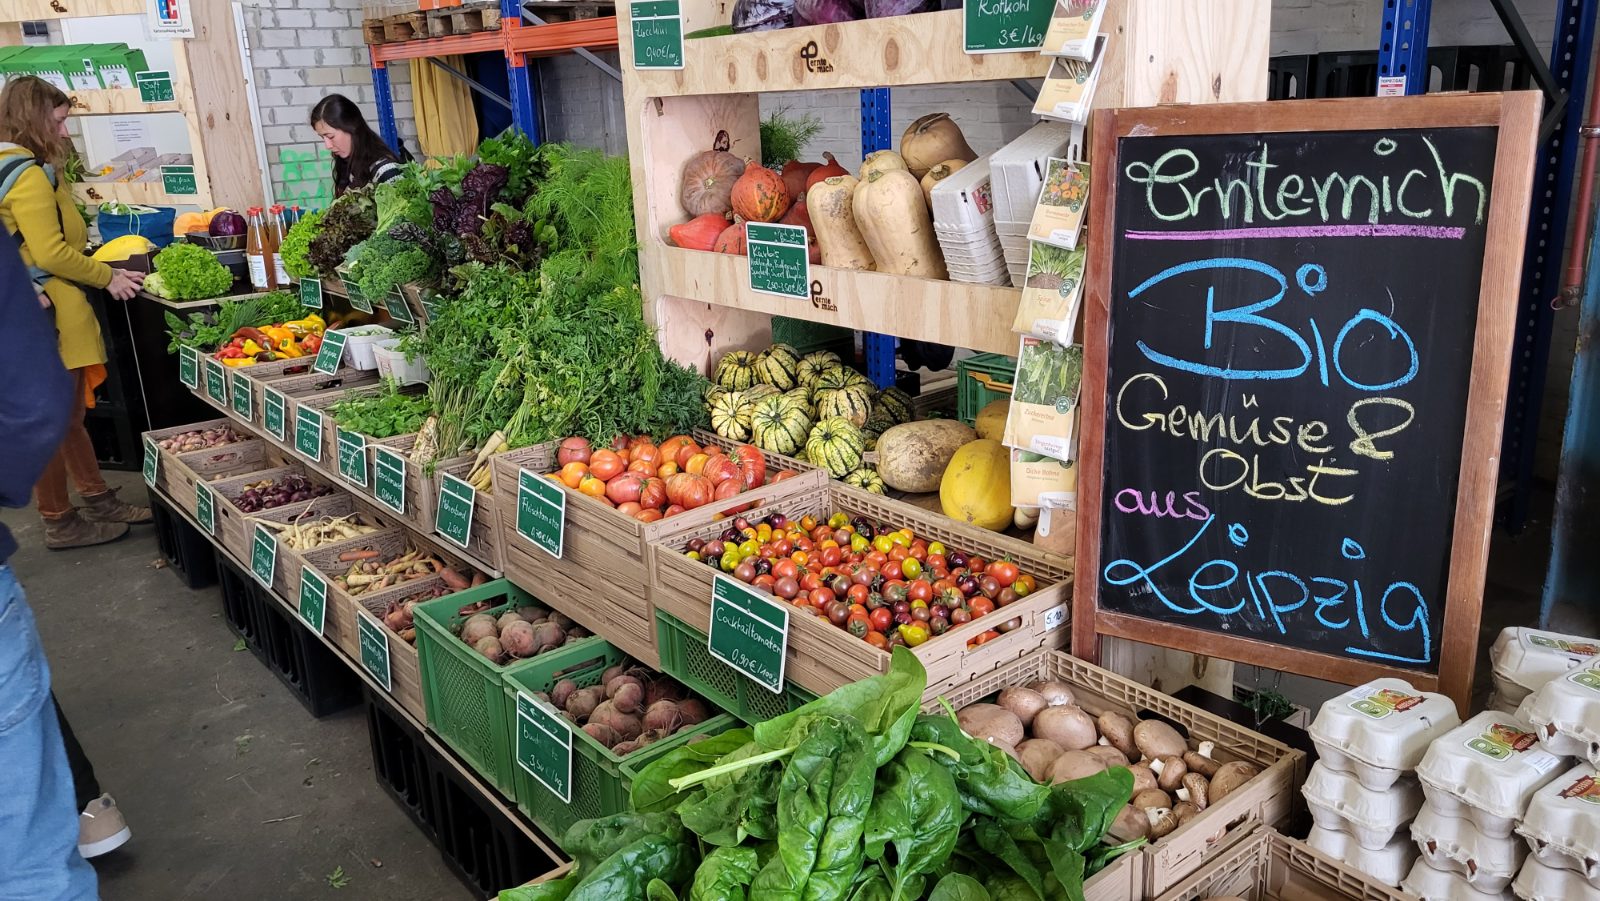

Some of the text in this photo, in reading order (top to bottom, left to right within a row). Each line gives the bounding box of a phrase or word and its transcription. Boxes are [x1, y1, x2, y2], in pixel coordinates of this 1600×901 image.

[978, 0, 1030, 17] Rotkohl
[1116, 373, 1333, 453] Gemüse
[1114, 487, 1211, 521] aus
[1200, 448, 1359, 507] Obst
[1104, 513, 1431, 663] Leipzig
